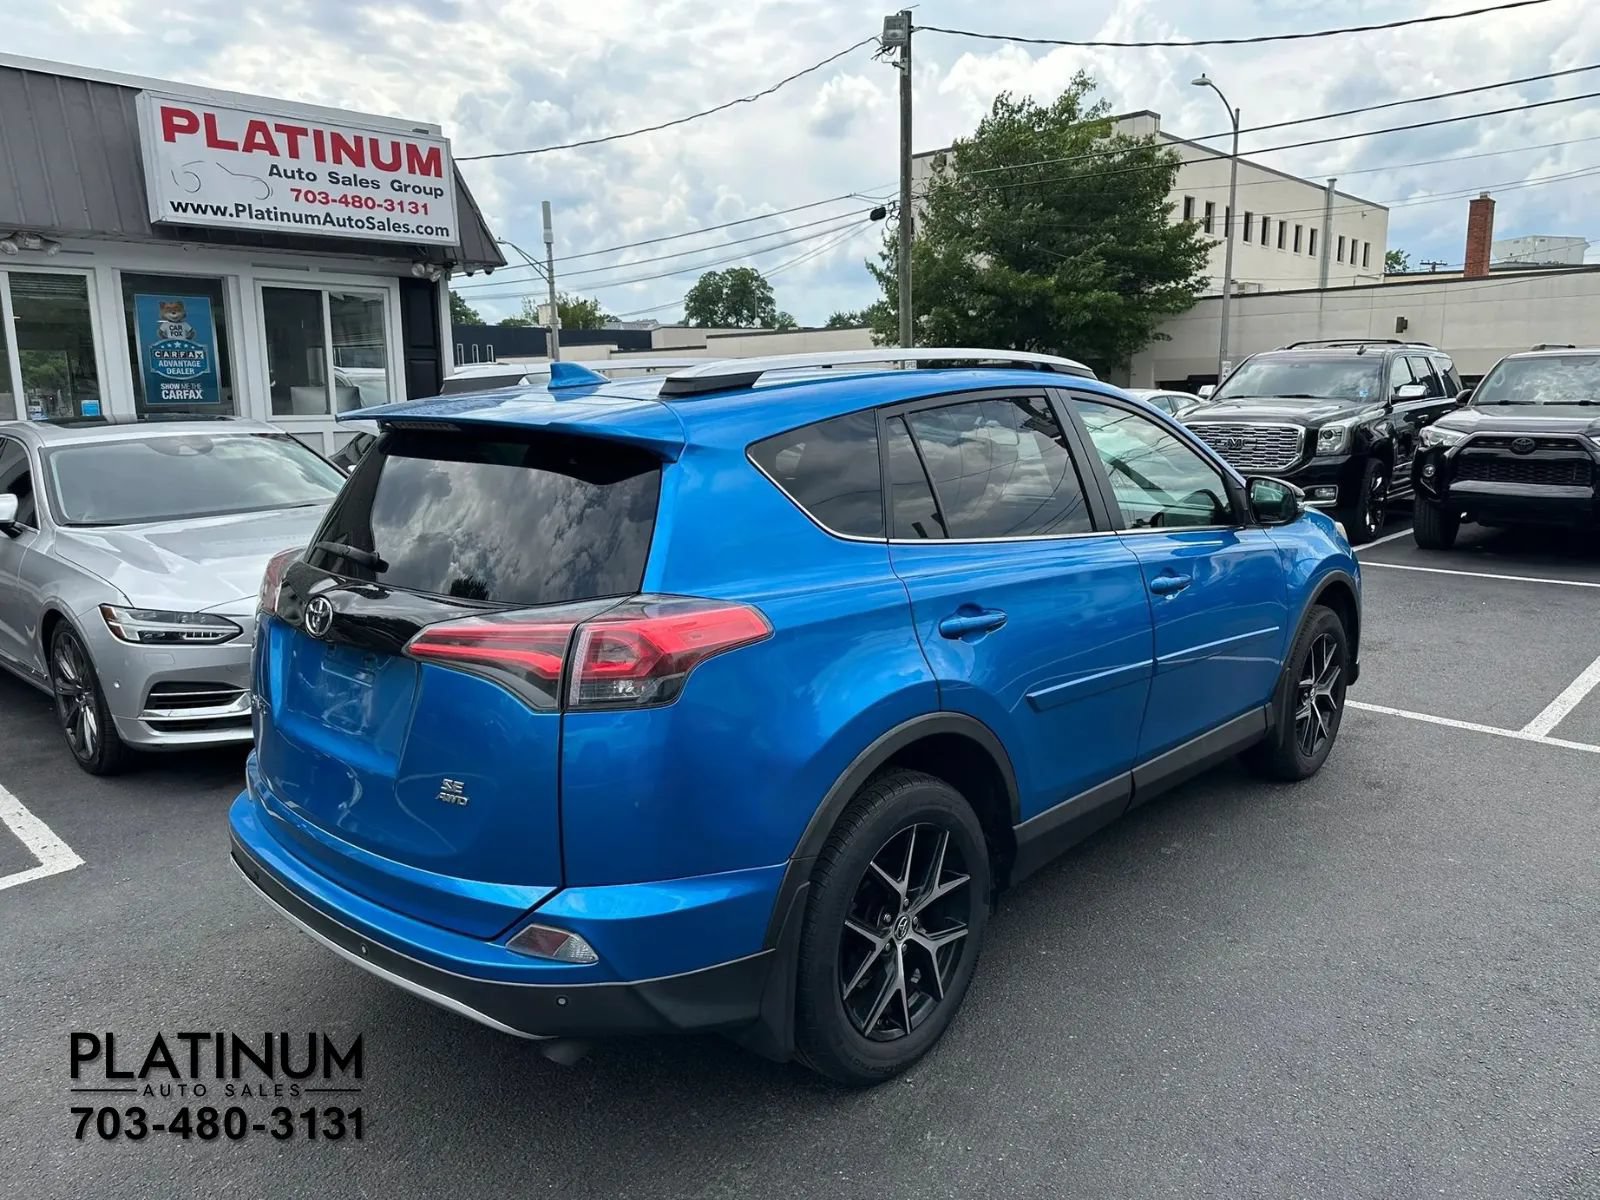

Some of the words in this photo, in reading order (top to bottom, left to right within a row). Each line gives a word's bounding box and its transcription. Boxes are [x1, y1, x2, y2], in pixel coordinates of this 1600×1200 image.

[160, 105, 443, 178] PLATINUM
[268, 163, 317, 182] Auto
[328, 171, 381, 190] Sales
[390, 179, 444, 198] Group
[290, 187, 429, 216] 703-480-3131
[170, 200, 449, 237] www.PlatinumAutoSales.com
[154, 350, 204, 359] CARFAX
[161, 389, 203, 400] CARFAX
[1214, 436, 1258, 450] GMC
[441, 778, 464, 793] SE
[435, 792, 468, 806] AWD
